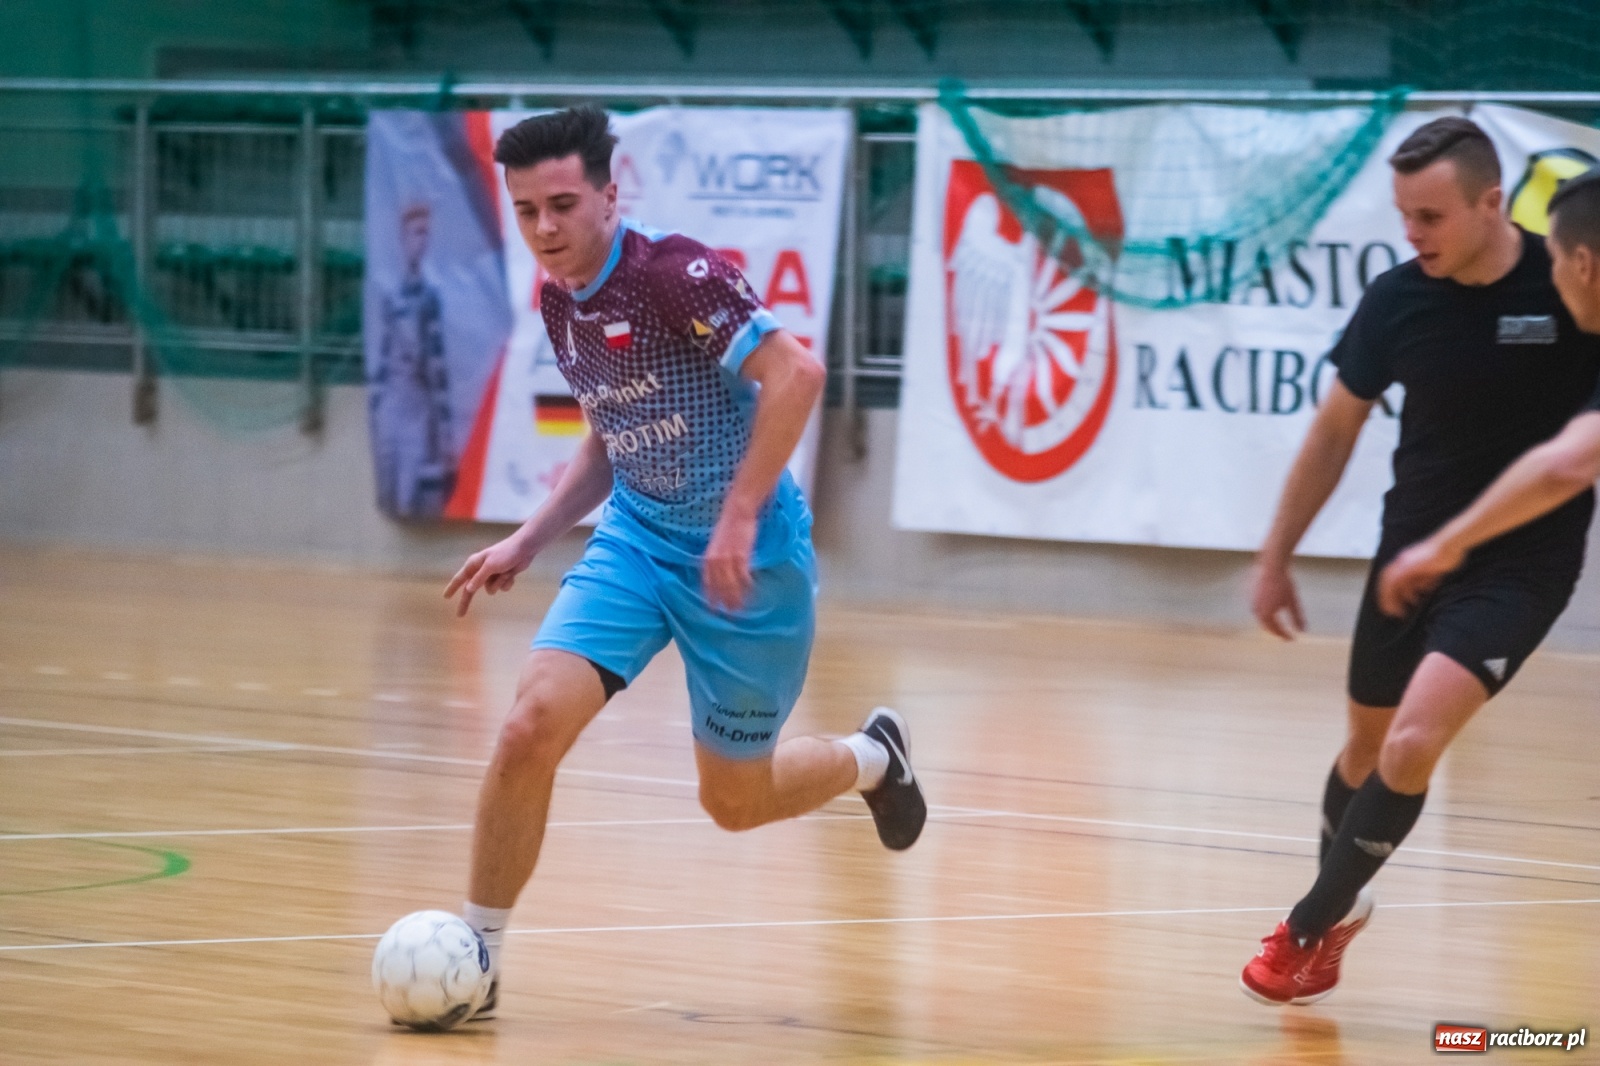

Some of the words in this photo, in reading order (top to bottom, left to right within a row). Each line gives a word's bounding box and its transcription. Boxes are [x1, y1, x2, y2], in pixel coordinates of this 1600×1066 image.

[693, 154, 821, 191] WORK
[1164, 236, 1398, 309] MIASTO
[602, 412, 689, 461] ROTIM
[706, 715, 773, 743] Int-Drew
